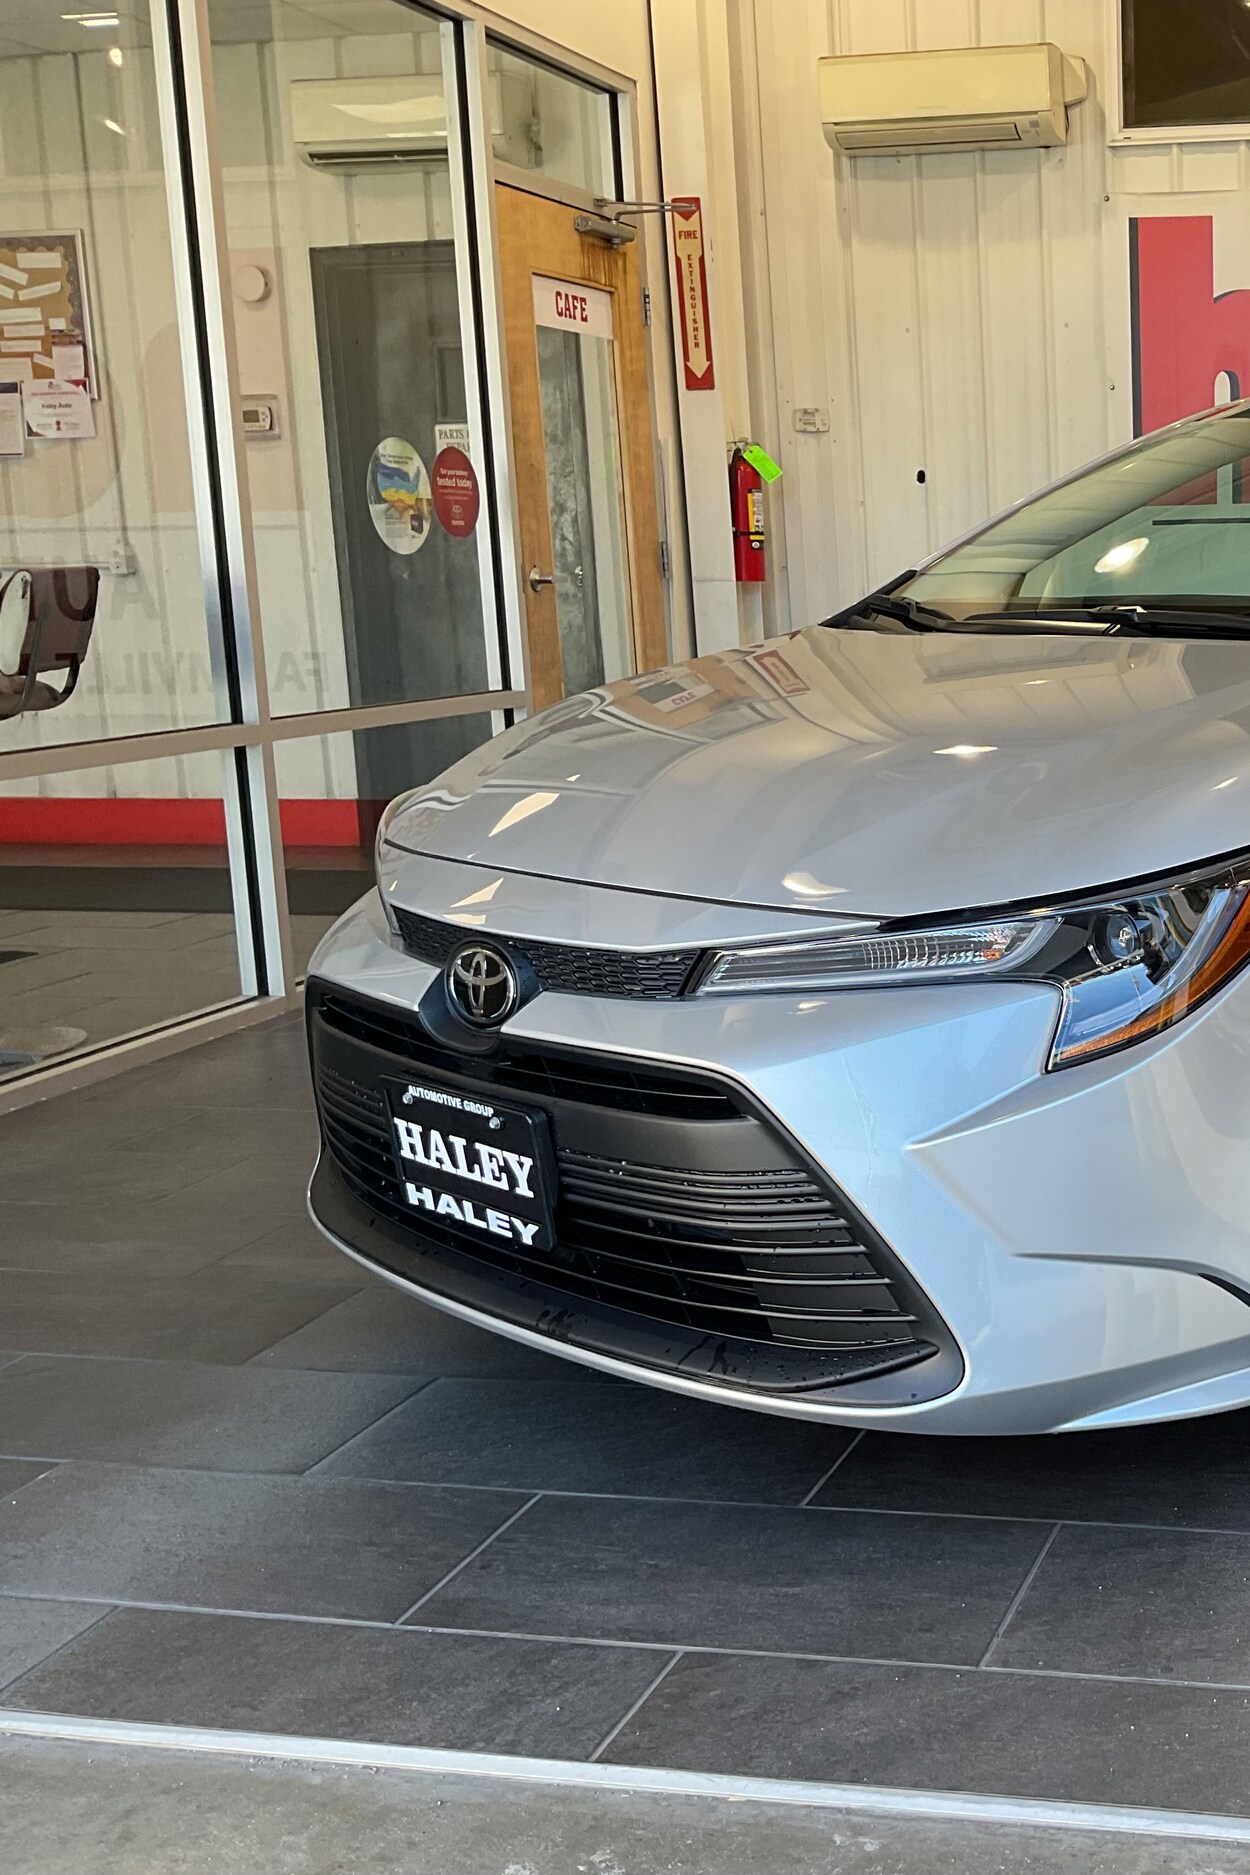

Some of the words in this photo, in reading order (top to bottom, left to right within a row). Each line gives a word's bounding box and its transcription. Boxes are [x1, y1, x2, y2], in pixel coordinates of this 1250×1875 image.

[678, 230, 699, 240] FIRE
[555, 290, 589, 323] CAFE
[687, 254, 700, 348] EXTINGUISHER
[438, 429, 465, 441] PARTS
[437, 476, 456, 487] tested
[456, 478, 473, 490] today
[407, 1085, 463, 1110] AUTOMOTIVE
[463, 1099, 495, 1118] GROUP
[393, 1117, 534, 1198] HALEY
[405, 1182, 540, 1246] HALEY
